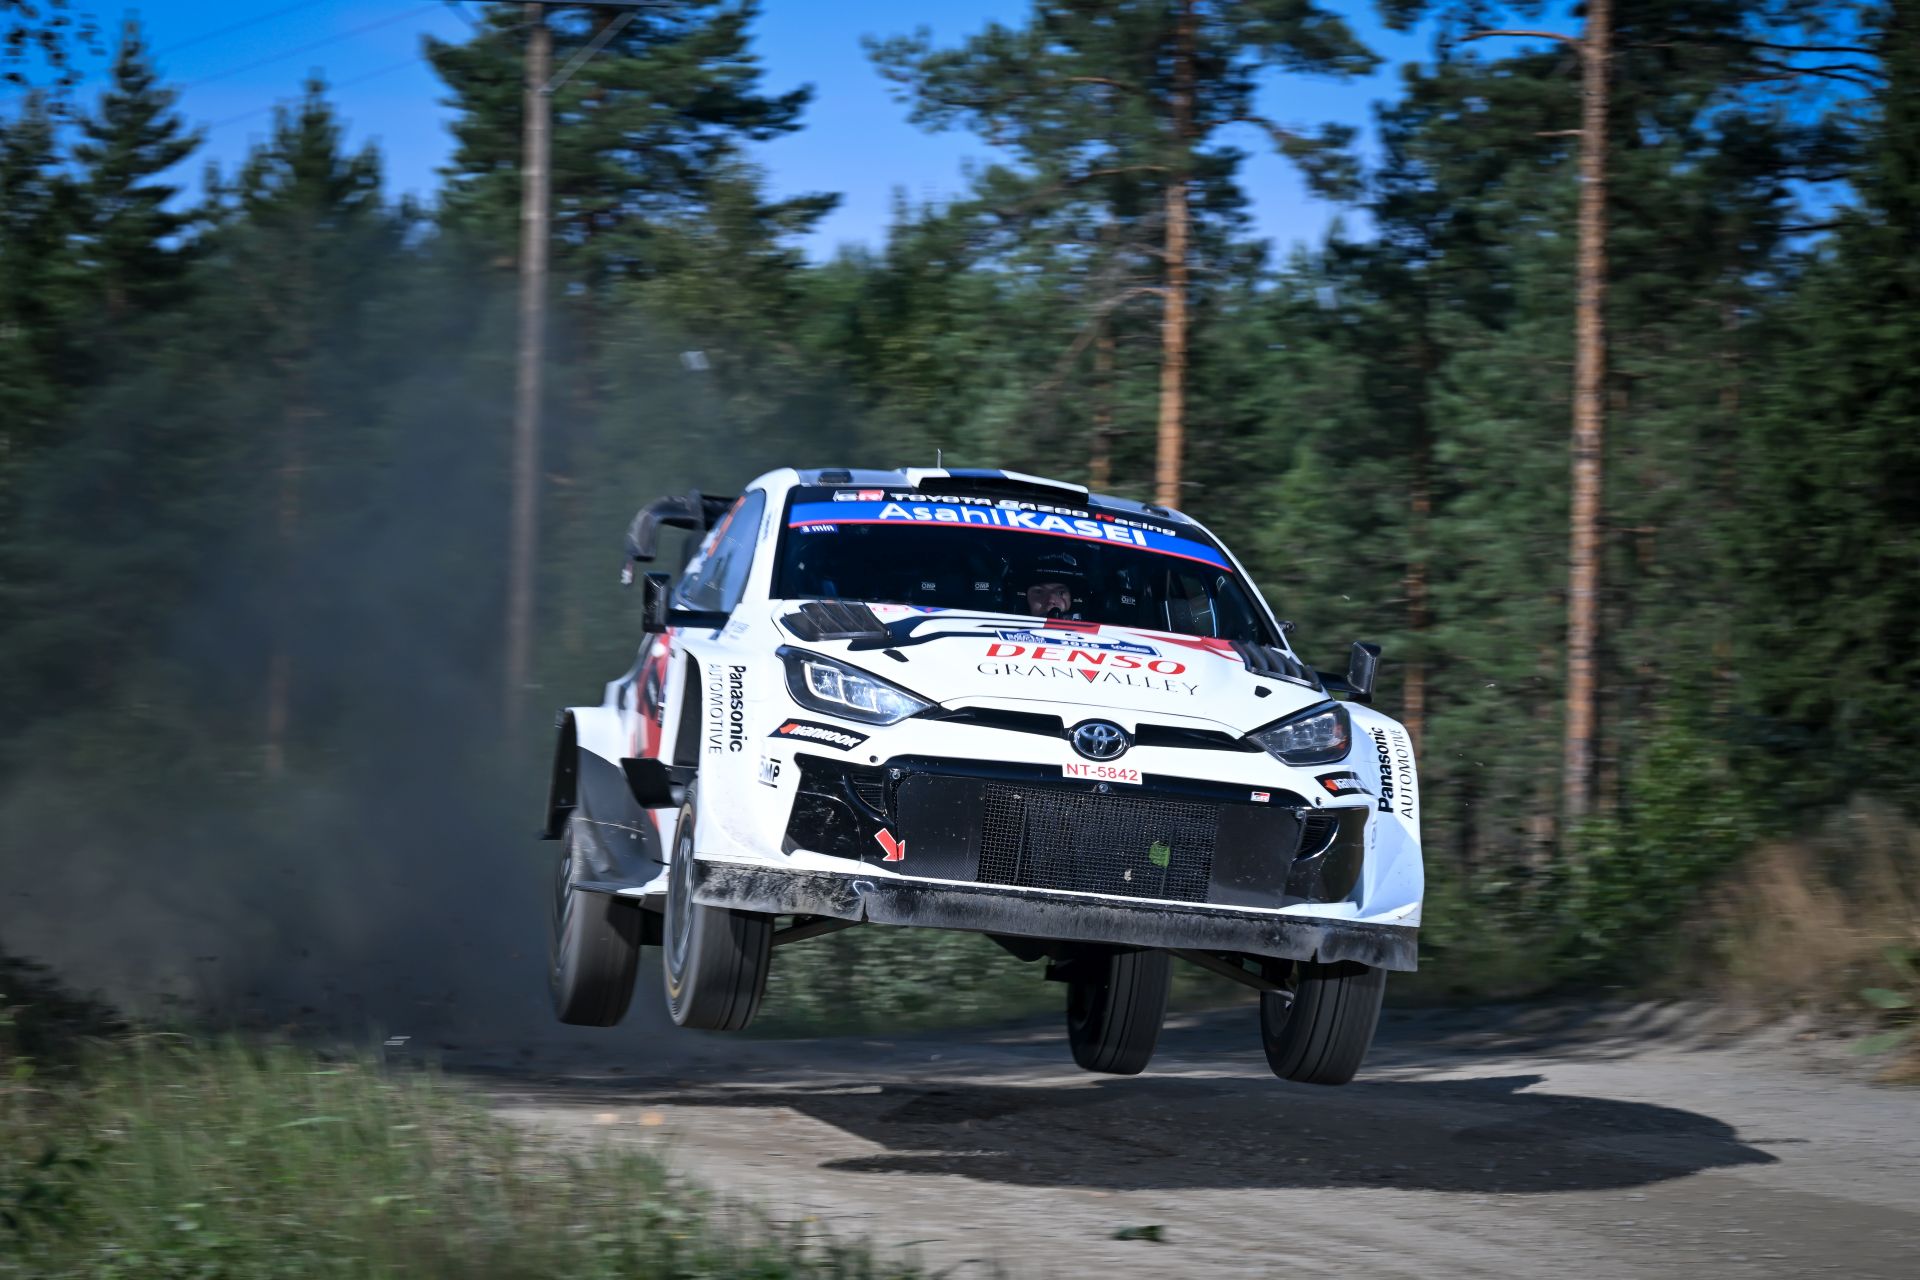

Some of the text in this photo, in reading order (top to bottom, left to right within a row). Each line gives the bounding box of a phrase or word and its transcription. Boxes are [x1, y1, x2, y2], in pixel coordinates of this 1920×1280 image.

[890, 493, 992, 506] TOYOTA
[1095, 513, 1177, 537] Racing
[974, 582, 990, 590] OMP
[985, 643, 1186, 675] DENSO
[708, 663, 724, 755] AUTOMOTIVE
[728, 665, 748, 753] Panasonic
[1066, 763, 1138, 781] NT-5842
[1368, 726, 1394, 814] Panasonic
[1389, 728, 1414, 820] AUTOMOTIVE
